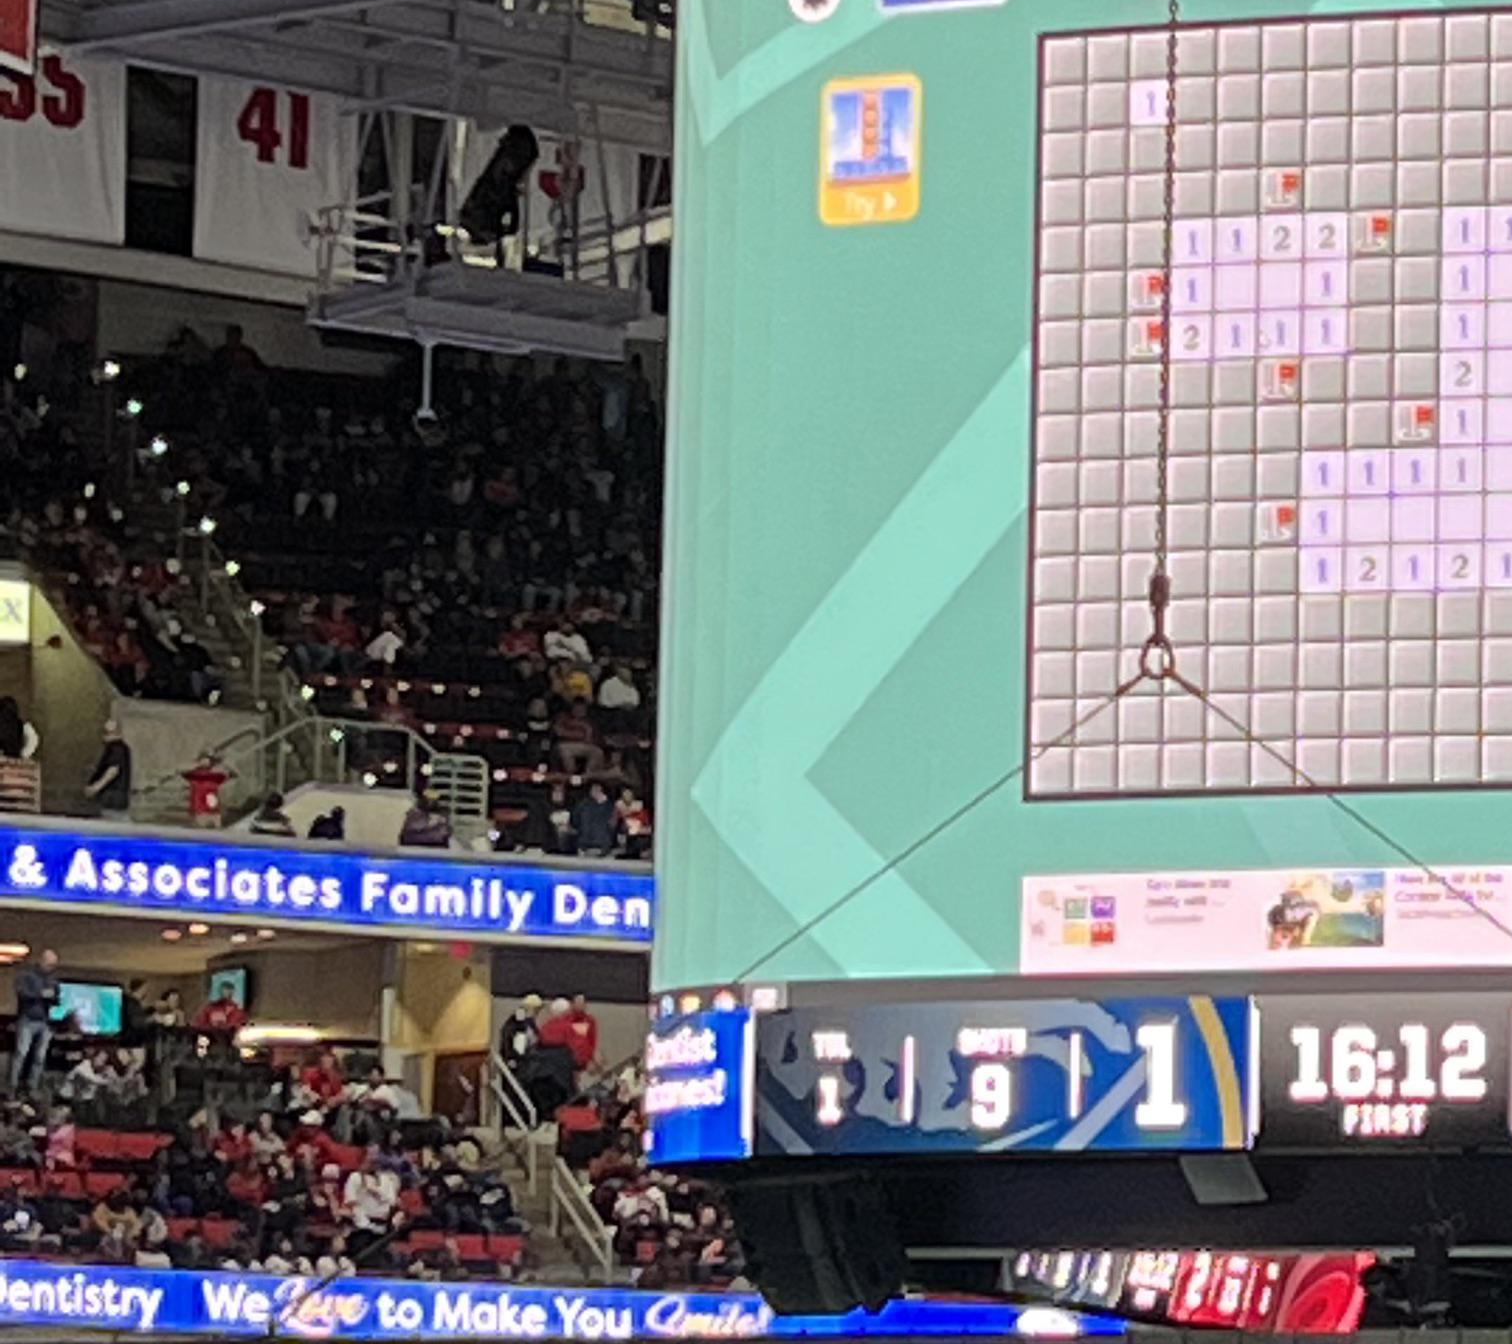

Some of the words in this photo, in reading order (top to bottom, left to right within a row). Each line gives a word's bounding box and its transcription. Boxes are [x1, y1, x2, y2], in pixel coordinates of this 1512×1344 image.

[1145, 89, 1157, 117] 1
[238, 87, 310, 169] 41
[1187, 229, 1200, 256] 1
[1231, 227, 1243, 253] 1
[1272, 224, 1292, 252] 2
[1317, 222, 1337, 250] 2
[1459, 217, 1471, 244] 1
[1186, 277, 1199, 303] 1
[1320, 271, 1333, 298] 1
[1458, 264, 1471, 292] 1
[1182, 324, 1201, 351] 2
[1230, 323, 1243, 349] 1
[1274, 319, 1288, 347] 1
[1319, 318, 1333, 345] 1
[1457, 313, 1470, 340] 1
[1453, 360, 1473, 388] 2
[1456, 408, 1468, 435] 1
[1317, 461, 1330, 487] 1
[1362, 460, 1376, 486] 1
[1409, 459, 1422, 485] 1
[1455, 457, 1468, 483] 1
[1316, 509, 1329, 536] 1
[1315, 557, 1329, 584] 1
[1358, 556, 1377, 583] 2
[1407, 555, 1420, 582] 1
[1451, 554, 1470, 580] 2
[1501, 552, 1512, 579] 1
[9, 845, 46, 888] &
[65, 847, 341, 911] Associates
[361, 873, 533, 933] Family
[553, 890, 650, 929] Den
[1135, 1020, 1185, 1128] 1
[1288, 1024, 1486, 1101] 16:12
[818, 1076, 842, 1125] 1
[971, 1065, 1010, 1128] 9
[1343, 1103, 1428, 1136] FIRST
[203, 1278, 271, 1323] We
[375, 1293, 424, 1330] to
[433, 1291, 546, 1335] Make
[553, 1295, 632, 1339] You
